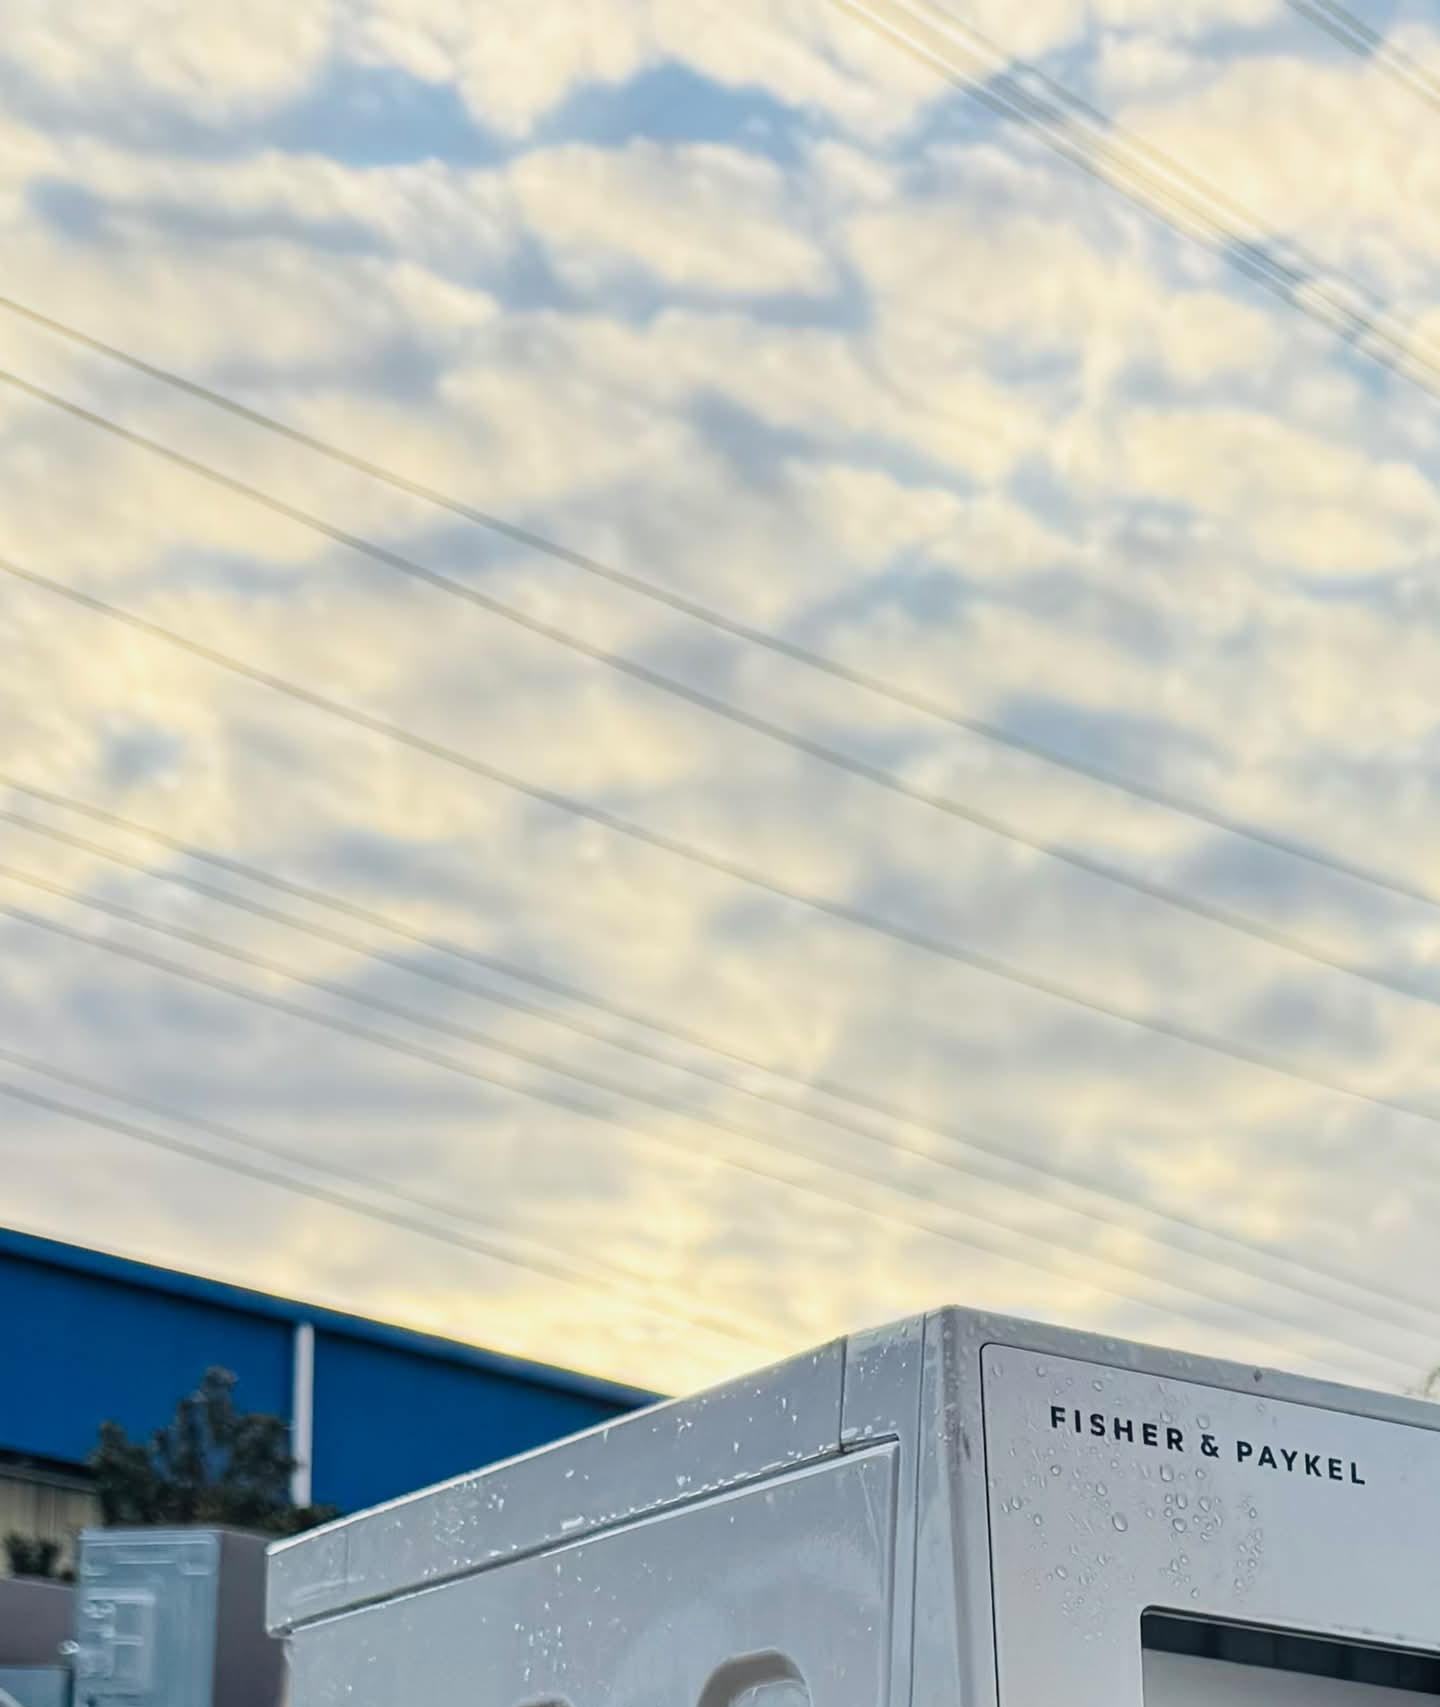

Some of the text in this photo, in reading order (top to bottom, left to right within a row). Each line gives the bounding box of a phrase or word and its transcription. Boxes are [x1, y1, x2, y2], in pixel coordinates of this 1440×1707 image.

[1049, 1405, 1366, 1486] FISHER & PAYKEL
